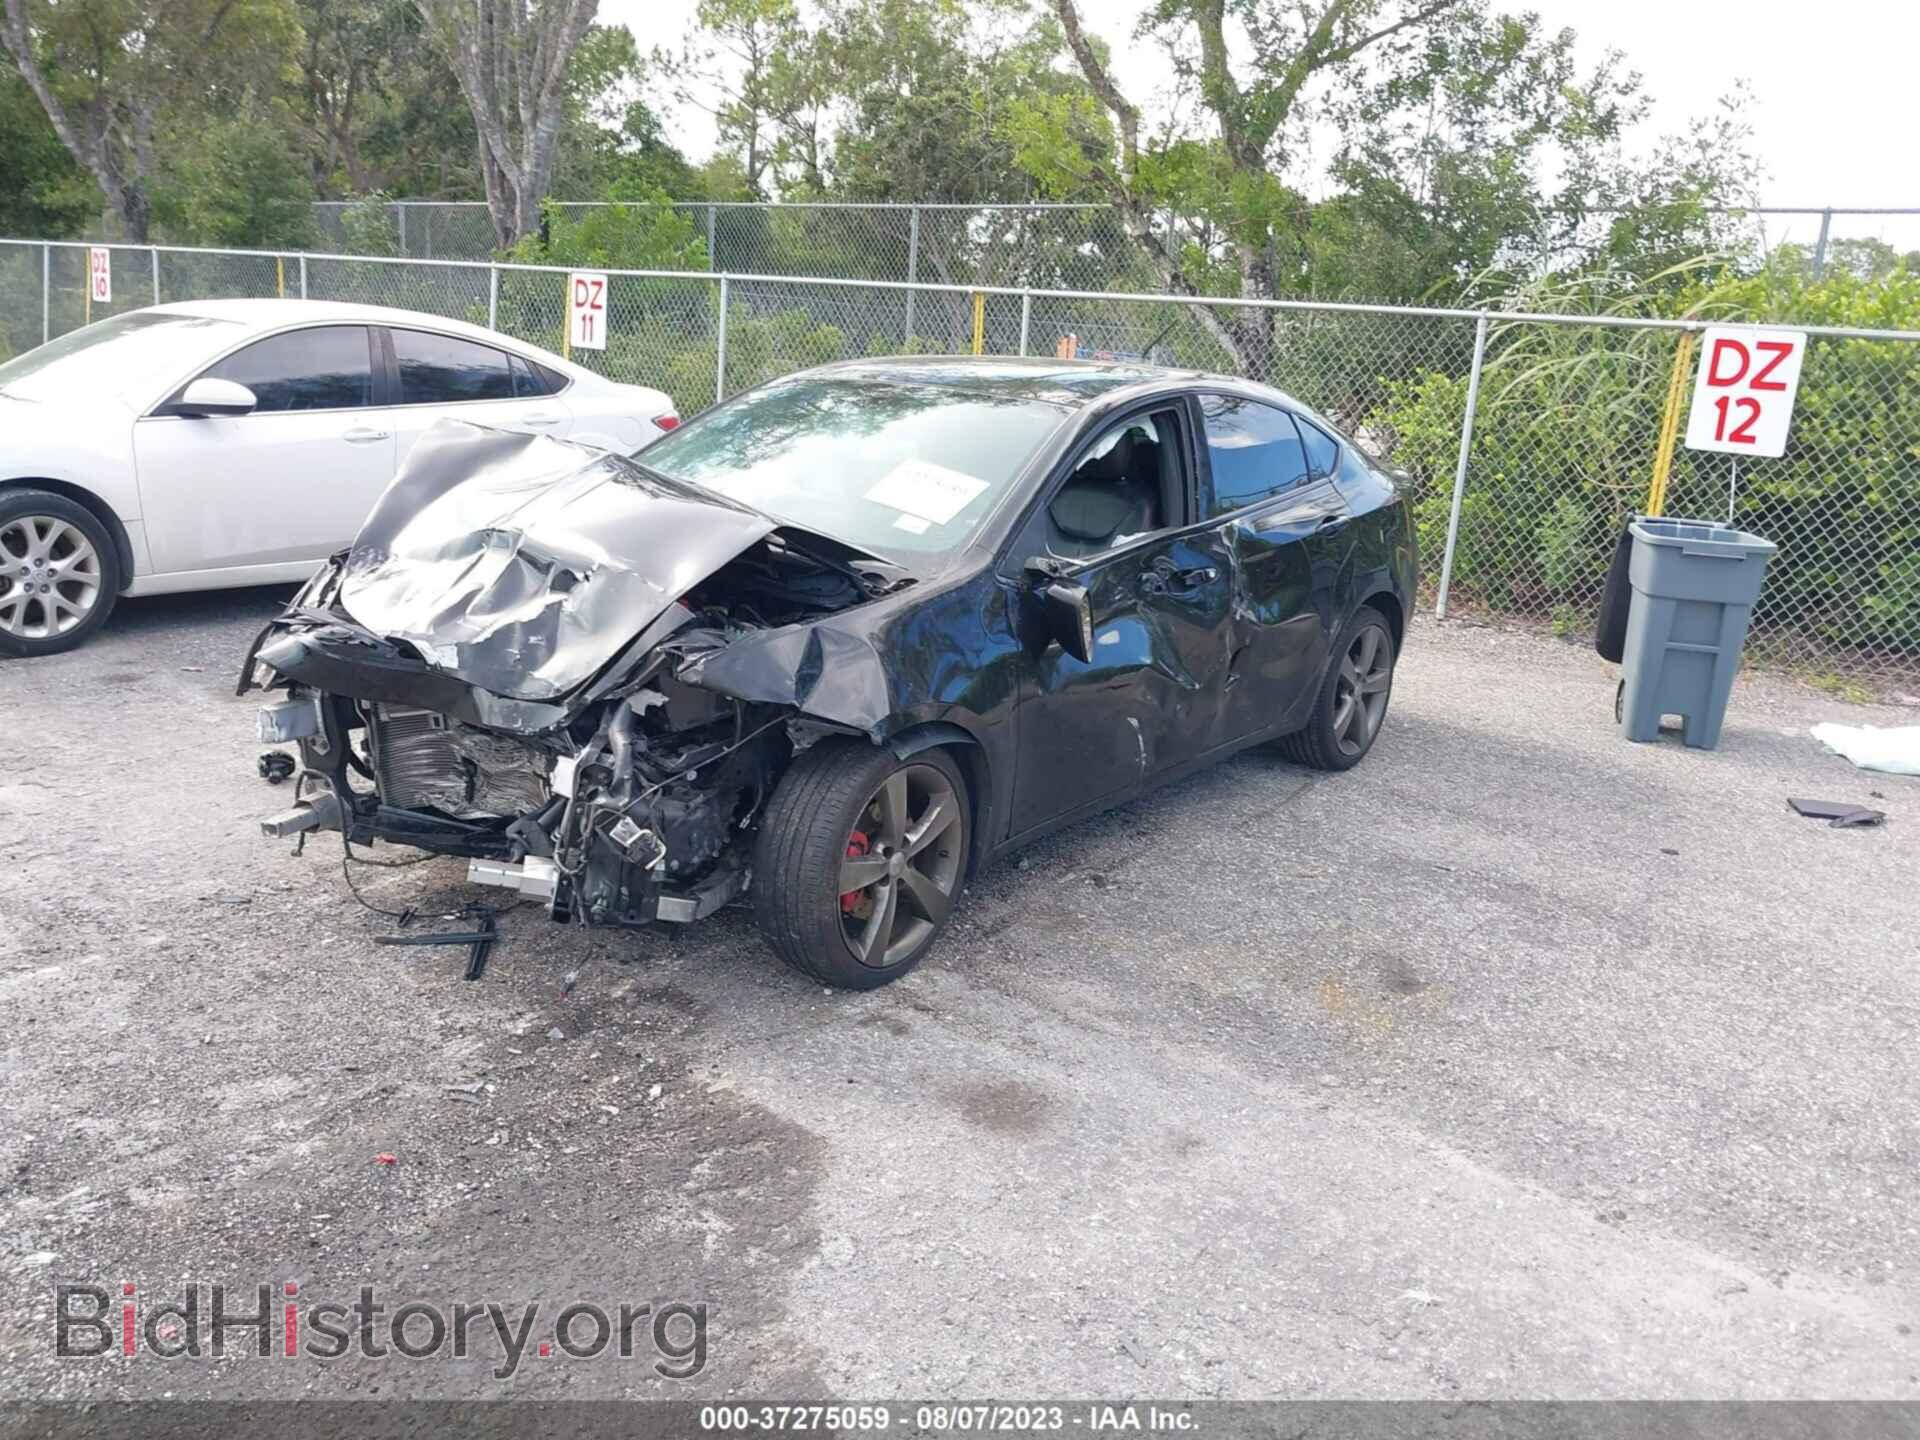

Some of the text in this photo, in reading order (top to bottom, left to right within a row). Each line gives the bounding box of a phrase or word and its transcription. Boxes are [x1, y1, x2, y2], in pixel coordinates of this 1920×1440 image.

[93, 252, 107, 273] DZ
[95, 276, 107, 296] 10
[575, 279, 603, 310] DZ
[581, 313, 594, 342] 11
[1707, 338, 1794, 392] DZ
[1714, 395, 1762, 444] 12
